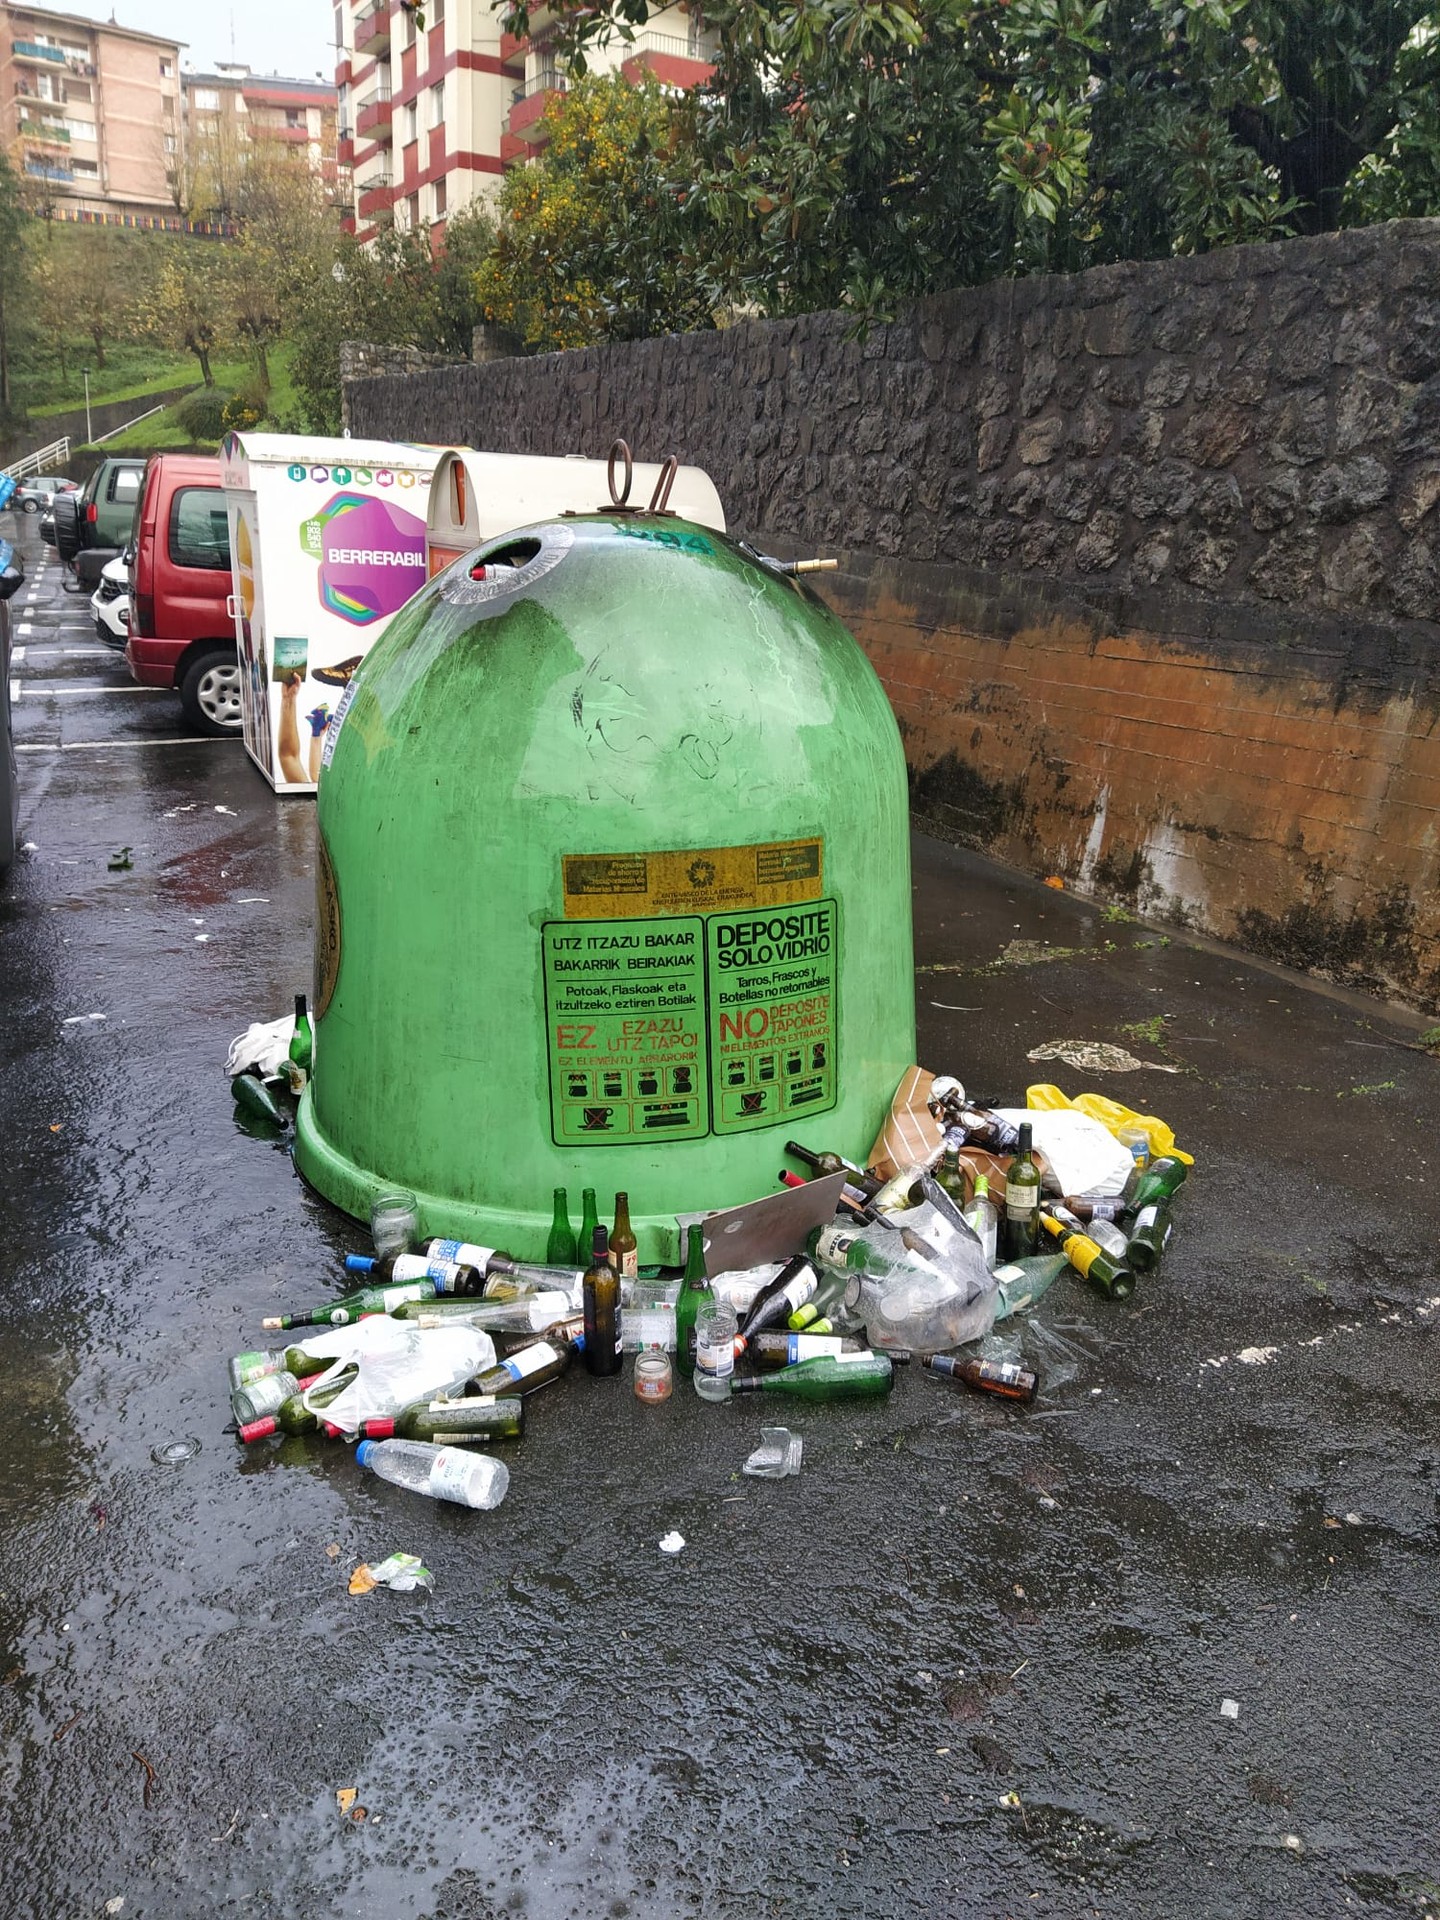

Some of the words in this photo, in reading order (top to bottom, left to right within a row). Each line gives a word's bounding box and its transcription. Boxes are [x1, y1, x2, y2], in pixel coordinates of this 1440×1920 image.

[328, 548, 426, 567] BERRERABIL
[717, 910, 830, 949] DEPOSITE
[553, 938, 582, 950] UTZ
[588, 935, 640, 950] ITZAZU
[645, 932, 695, 947] BAKAR
[718, 945, 774, 969] SOLO
[776, 934, 830, 961] VIDRIO
[554, 958, 621, 971] BAKARRIK
[627, 954, 696, 970] BEIRAKIAK
[736, 975, 772, 988] Tarros,
[772, 967, 810, 983] Frascos
[811, 967, 818, 981] y
[612, 983, 664, 996] Flaskoak
[668, 982, 687, 993] eta
[719, 989, 764, 1004] Botellas
[765, 987, 779, 998] no
[779, 975, 831, 995] retornables
[555, 998, 612, 1011] itzultzeko
[615, 997, 655, 1009] eztiren
[658, 994, 696, 1007] Botilak
[720, 1008, 769, 1042] NO
[770, 995, 831, 1019] DEPOSITE
[771, 1010, 827, 1035] TAPONES
[557, 1025, 597, 1050] EZ
[622, 1018, 684, 1035] EZAZU
[607, 1036, 643, 1052] UTZ
[731, 1036, 787, 1053] ELEMENTOS
[558, 1056, 573, 1066] EZ
